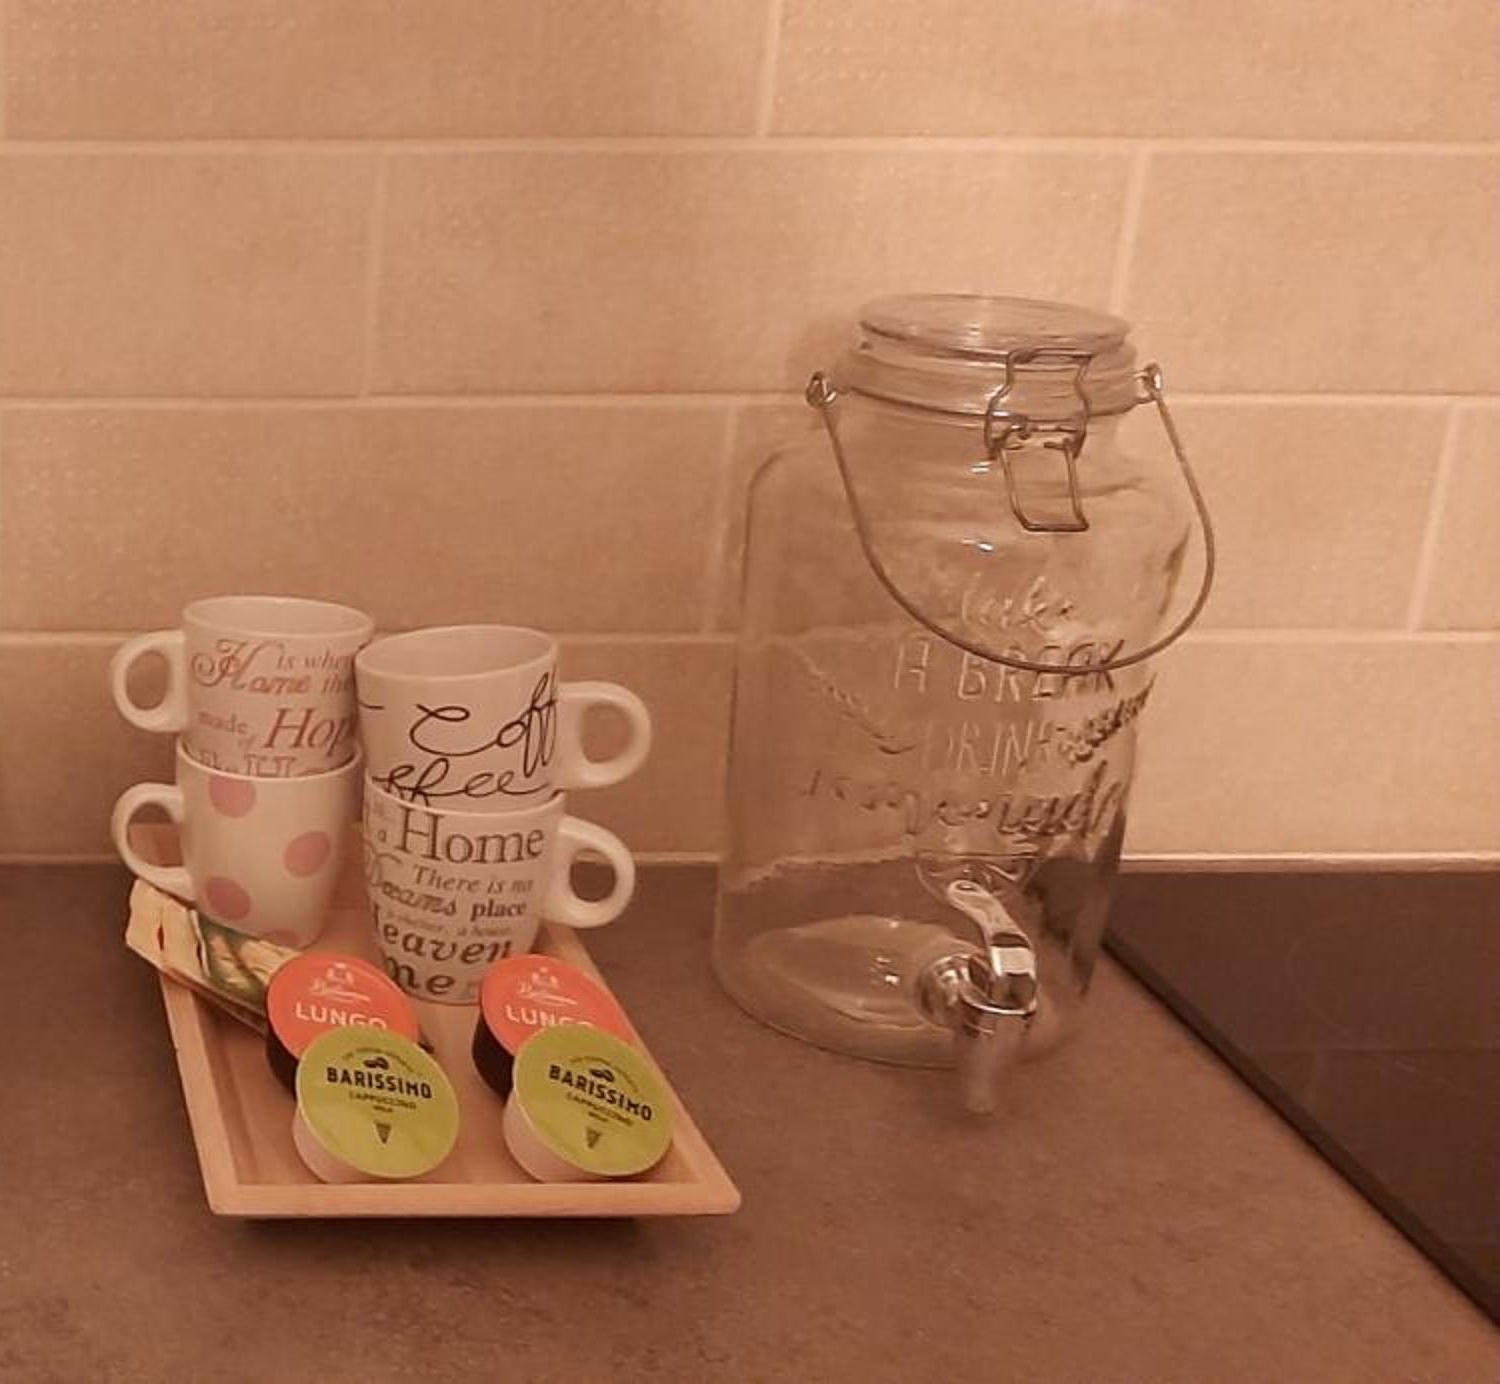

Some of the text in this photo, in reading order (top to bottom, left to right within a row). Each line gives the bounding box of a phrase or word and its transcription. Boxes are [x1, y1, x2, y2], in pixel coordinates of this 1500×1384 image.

[393, 806, 545, 863] Home
[413, 864, 480, 894] There
[469, 898, 527, 922] place
[326, 1066, 434, 1100] BARISSIMO
[548, 1063, 653, 1121] BARISSIMO
